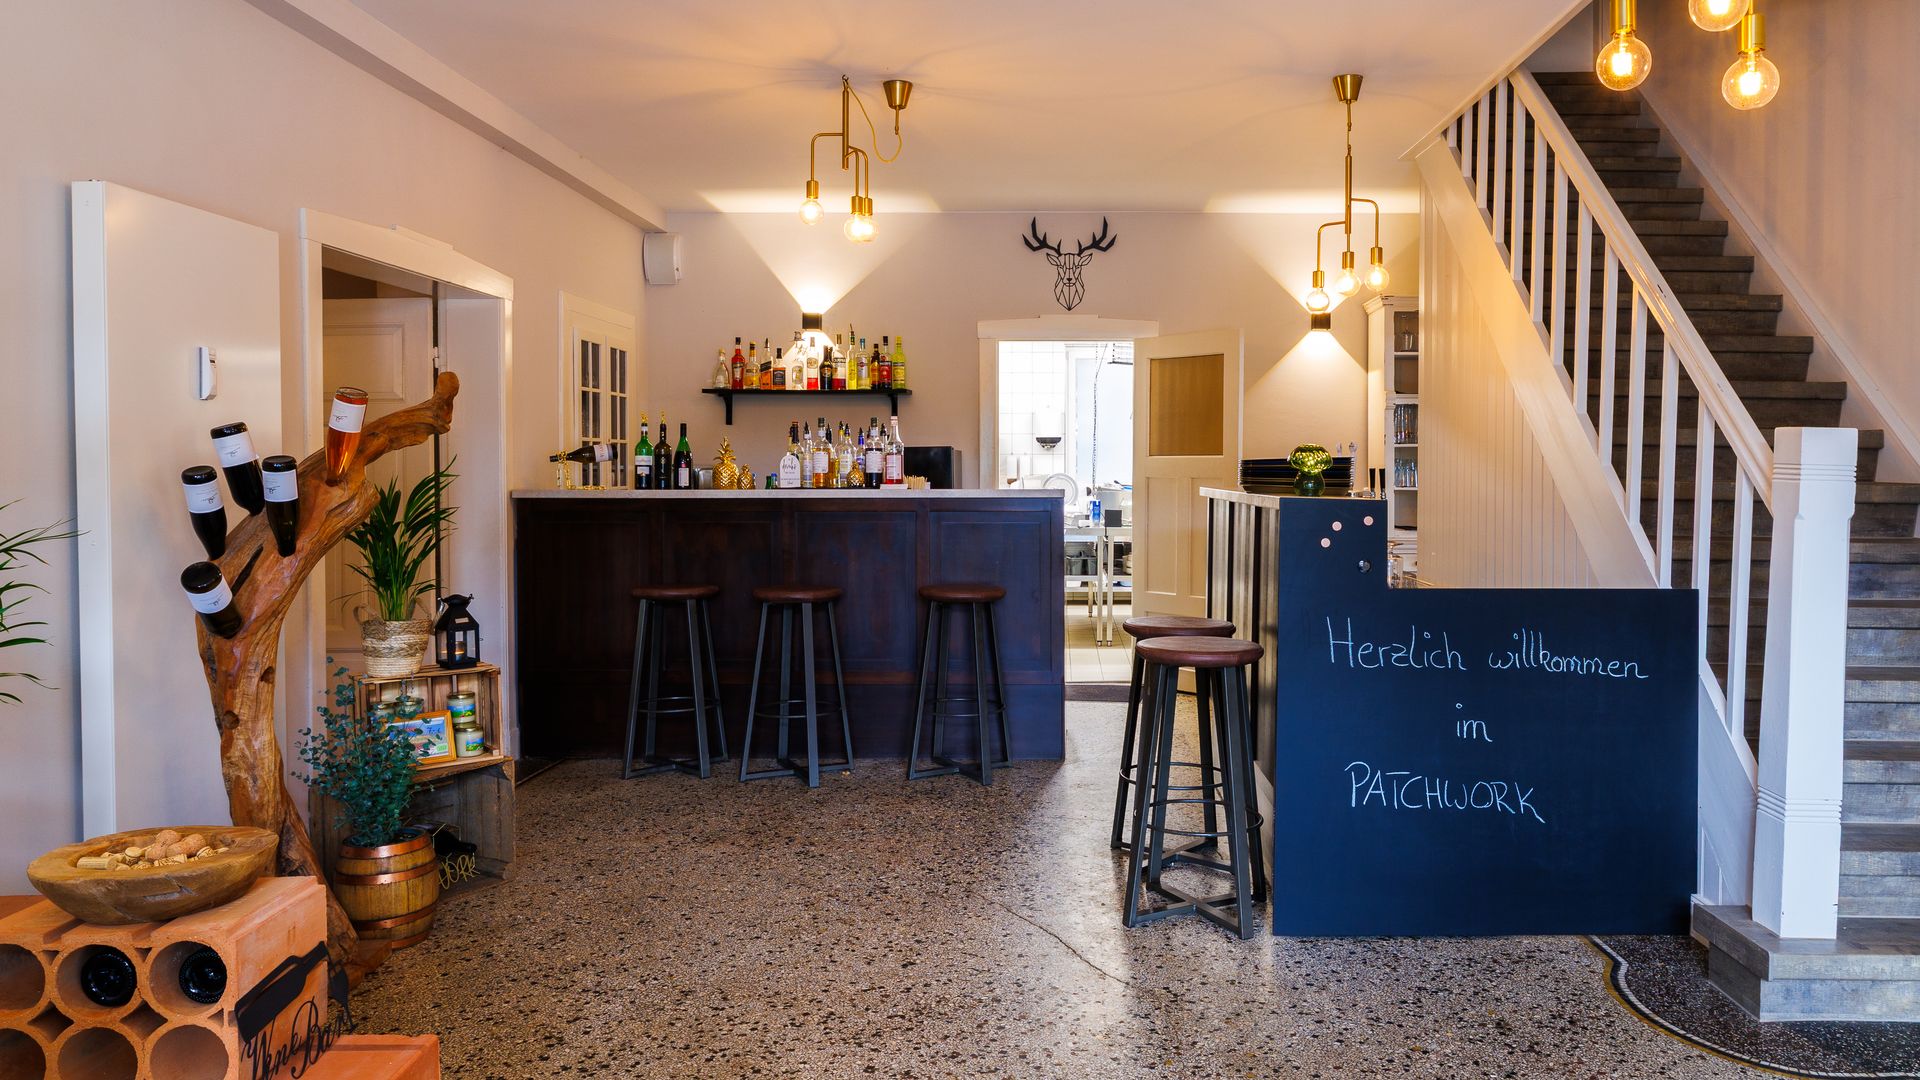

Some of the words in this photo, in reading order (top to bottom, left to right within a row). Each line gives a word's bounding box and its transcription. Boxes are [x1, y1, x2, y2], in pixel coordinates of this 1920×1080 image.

[1326, 616, 1467, 670] Herzlich
[1488, 628, 1649, 679] willkommen
[1455, 702, 1493, 742] im
[1344, 761, 1546, 823] PATCHWORK
